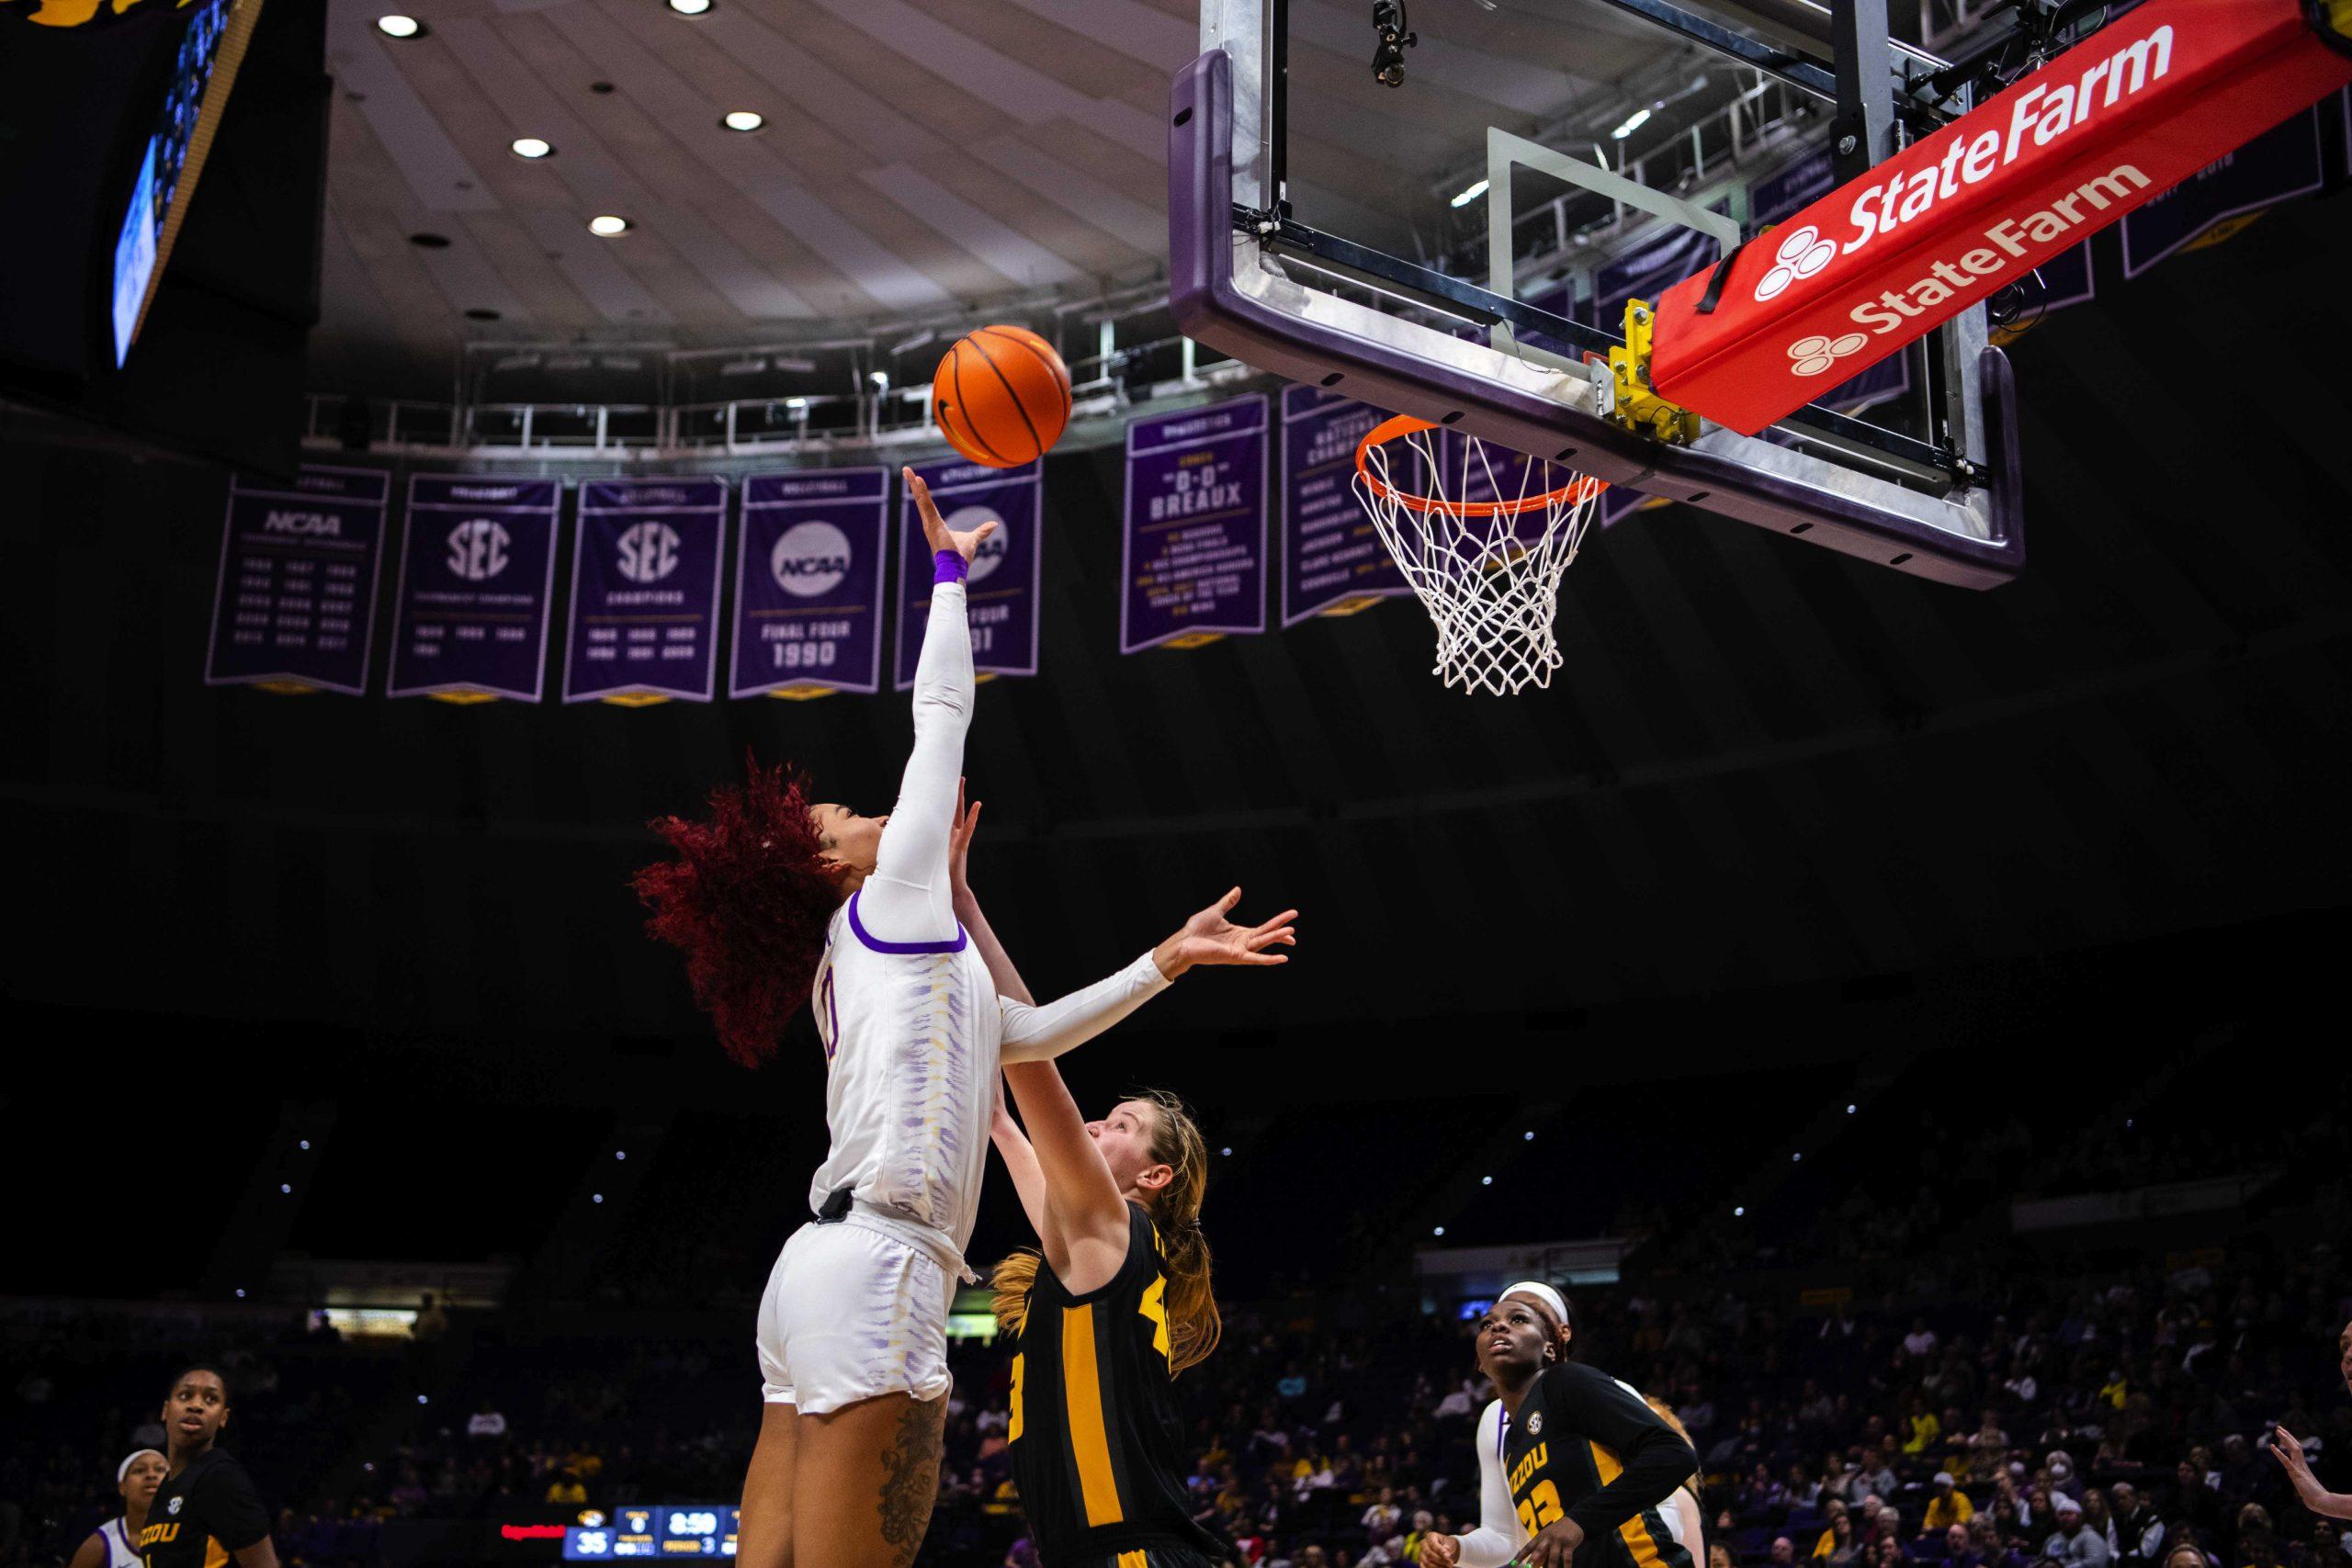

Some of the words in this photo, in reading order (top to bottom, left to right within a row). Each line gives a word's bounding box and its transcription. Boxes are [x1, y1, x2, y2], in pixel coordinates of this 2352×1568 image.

[1149, 480, 1242, 521] BREAUX
[263, 509, 343, 536] NCAA
[446, 517, 512, 581] SEC
[616, 520, 682, 583] SEC
[779, 556, 847, 576] NCAA
[761, 624, 806, 642] FINAL
[808, 620, 851, 640] FOUR
[773, 640, 836, 669] 1990
[576, 1530, 607, 1554] 35
